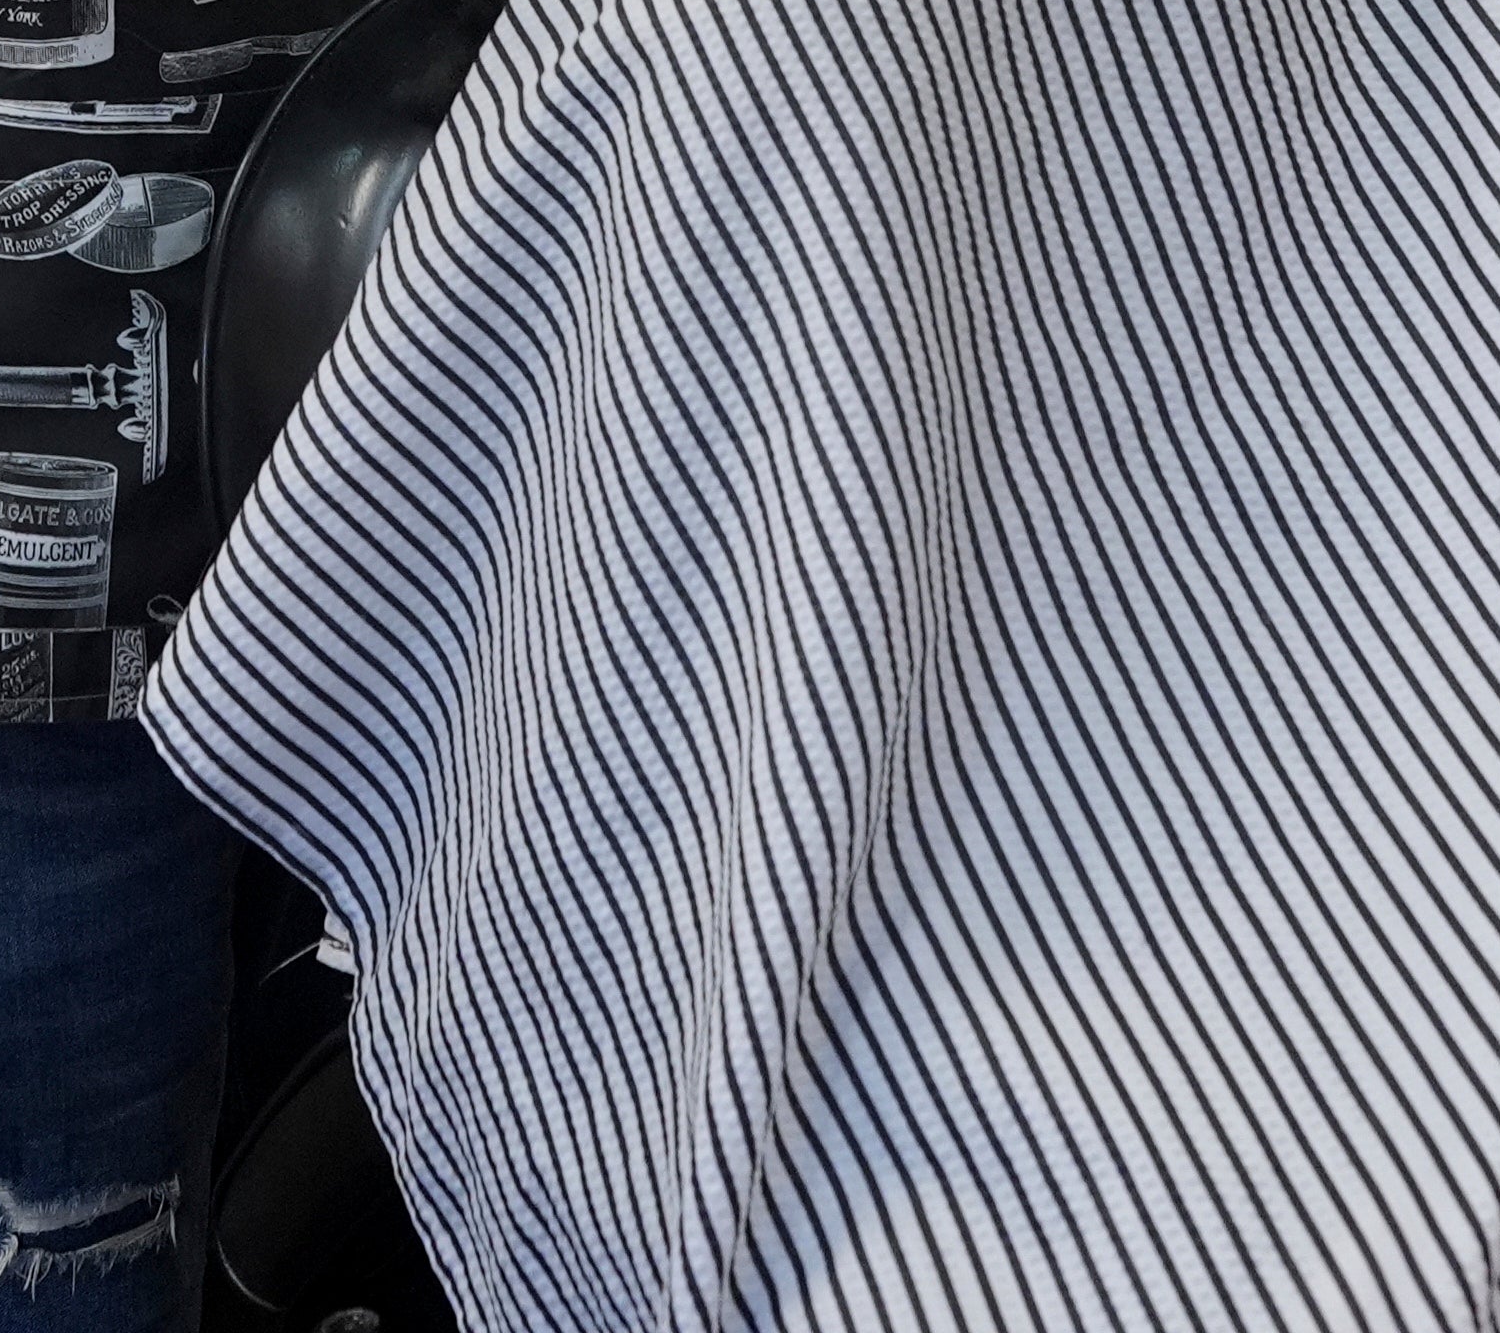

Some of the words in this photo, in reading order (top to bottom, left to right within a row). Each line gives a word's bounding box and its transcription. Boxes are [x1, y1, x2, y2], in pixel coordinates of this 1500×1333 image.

[40, 171, 110, 225] DRESSING
[2, 236, 53, 253] RAZORS
[53, 228, 67, 244] &
[65, 510, 80, 526] &
